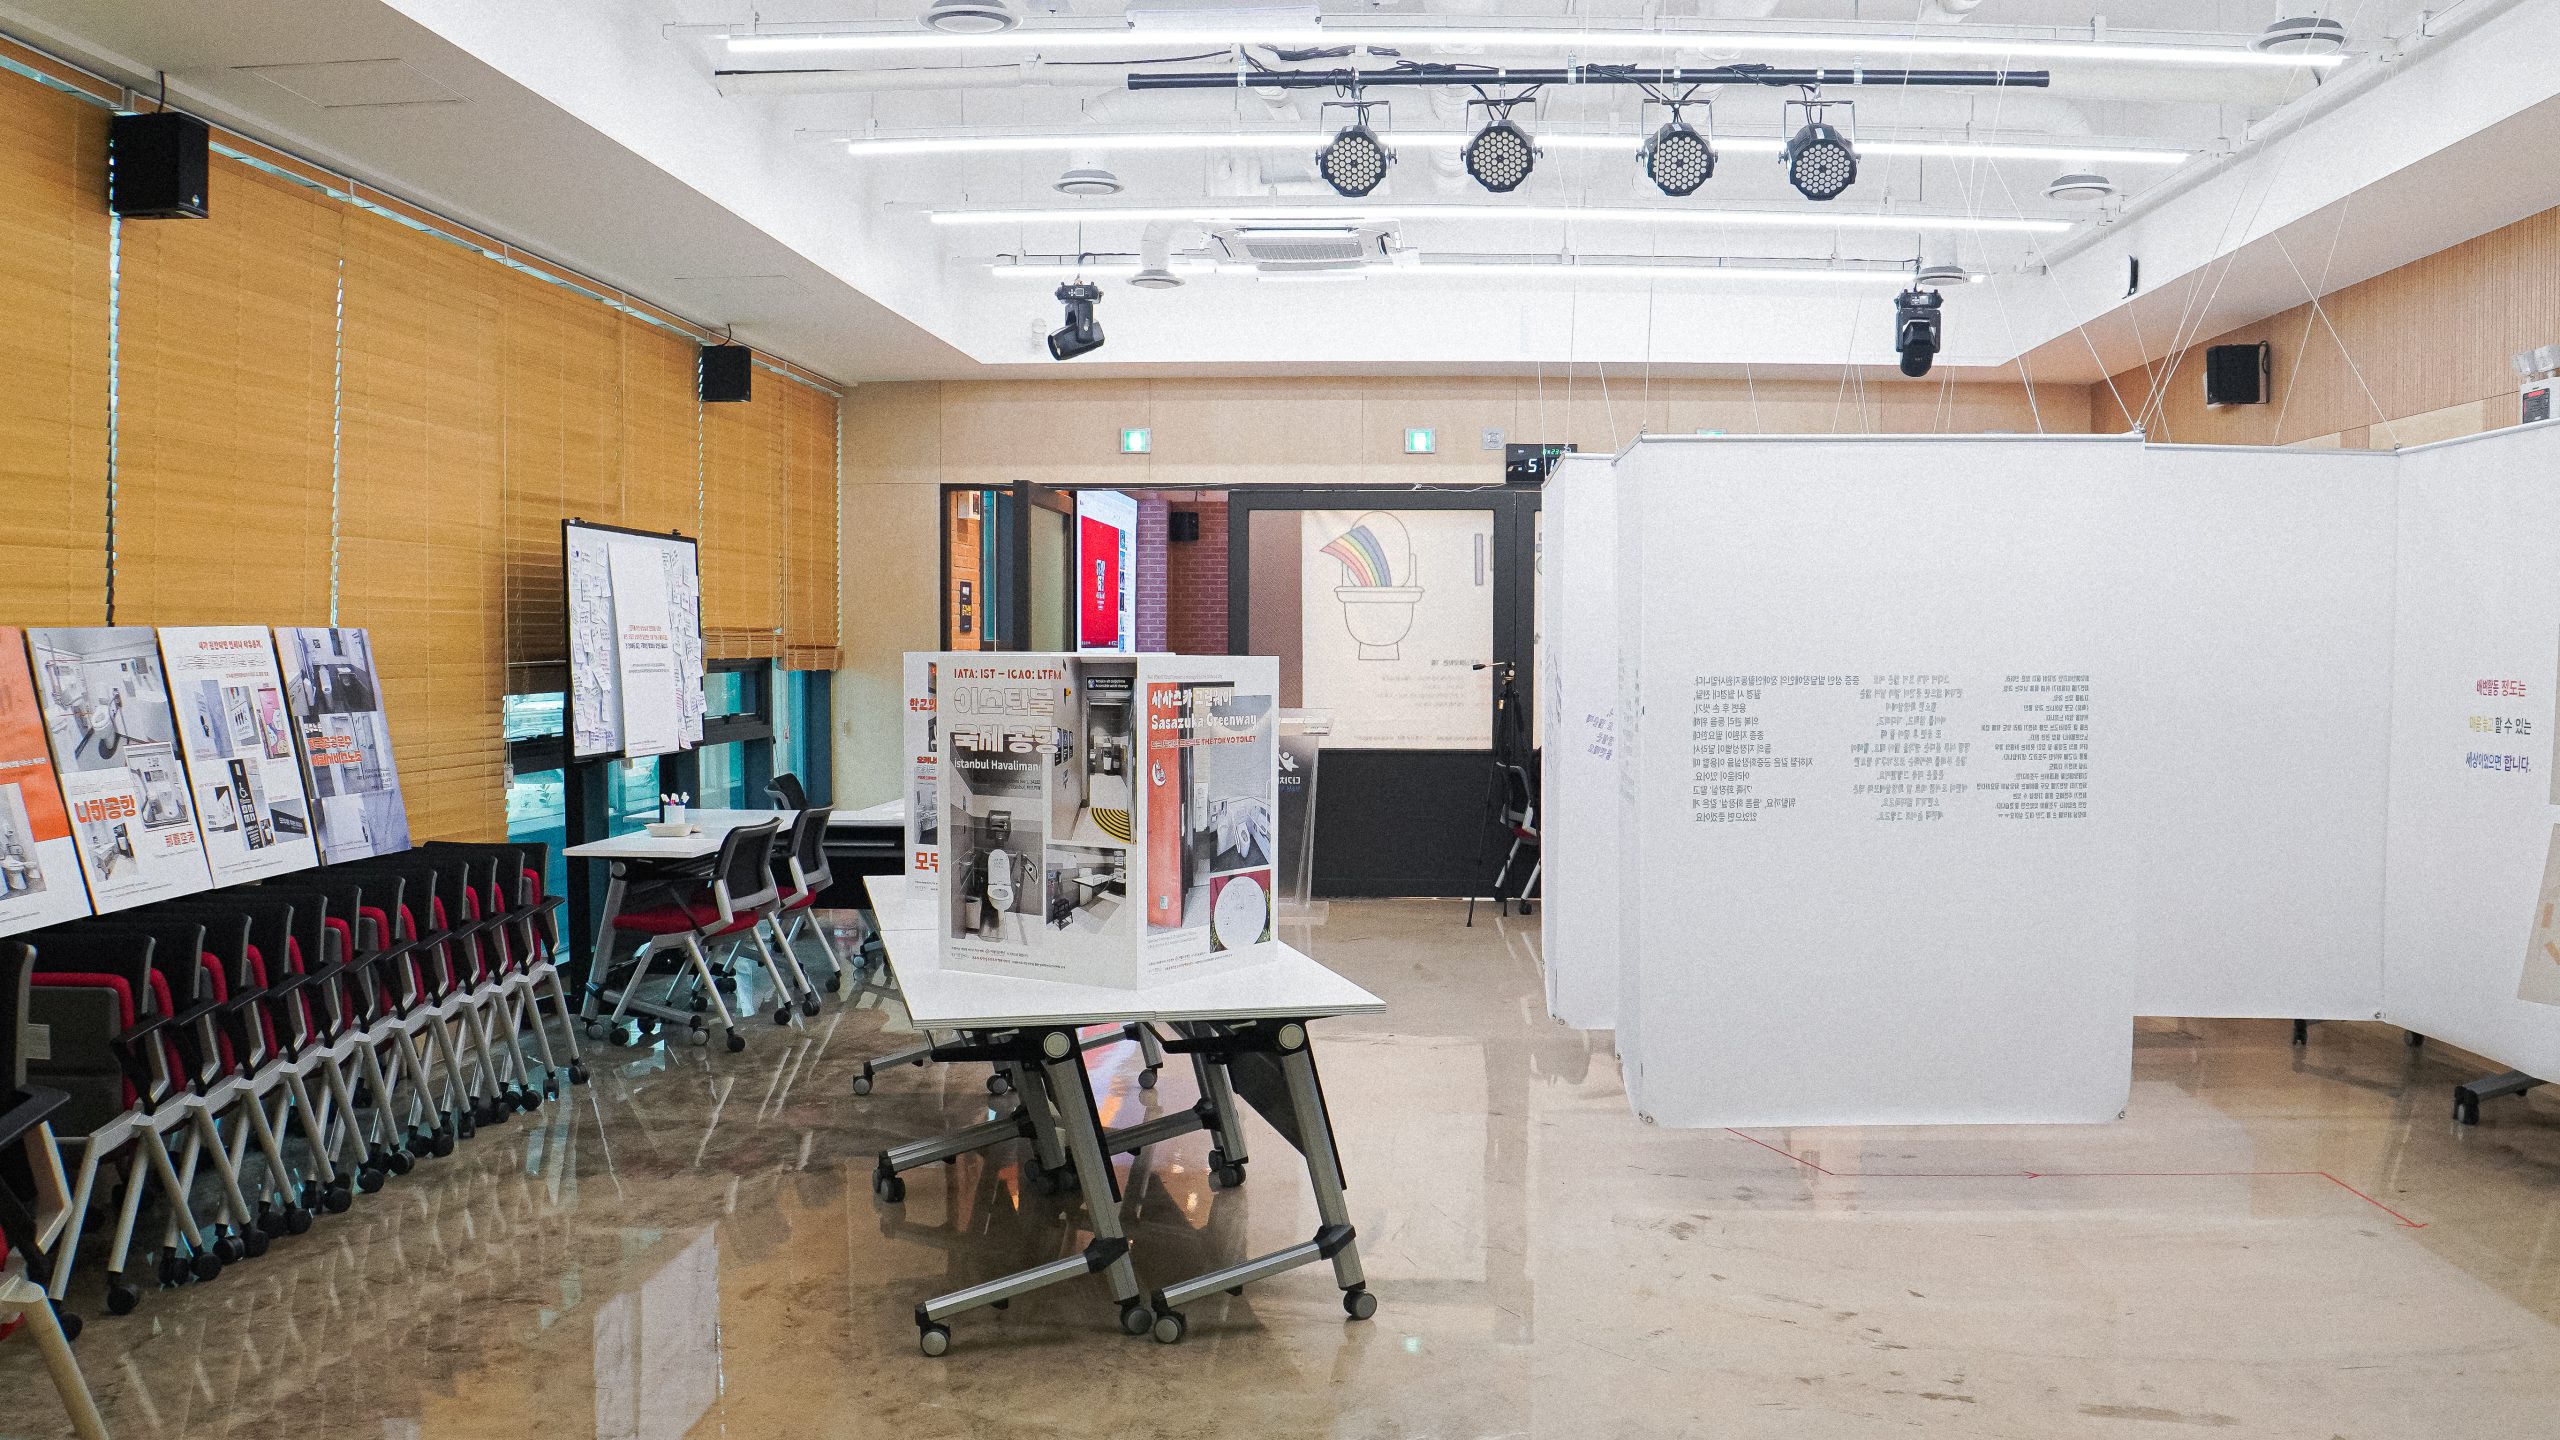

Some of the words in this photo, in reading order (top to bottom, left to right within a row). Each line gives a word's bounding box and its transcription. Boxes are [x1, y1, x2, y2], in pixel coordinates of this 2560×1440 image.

[954, 668, 978, 679] IATA:
[980, 669, 996, 679] IST
[1007, 669, 1035, 680] ICAO:
[2476, 678, 2499, 697] 배변활동
[2502, 679, 2527, 697] 정도는
[954, 686, 1055, 717] 이스탄불
[1151, 714, 1204, 730] Sasazuka
[1206, 712, 1257, 731] Greenway
[2495, 716, 2502, 734] 할
[2504, 717, 2512, 735] 수
[2515, 717, 2532, 736] 있는
[954, 723, 1004, 753] 국제
[1008, 724, 1059, 754] 공항
[2504, 754, 2532, 774] 합니다.
[74, 794, 137, 824] 나하공항
